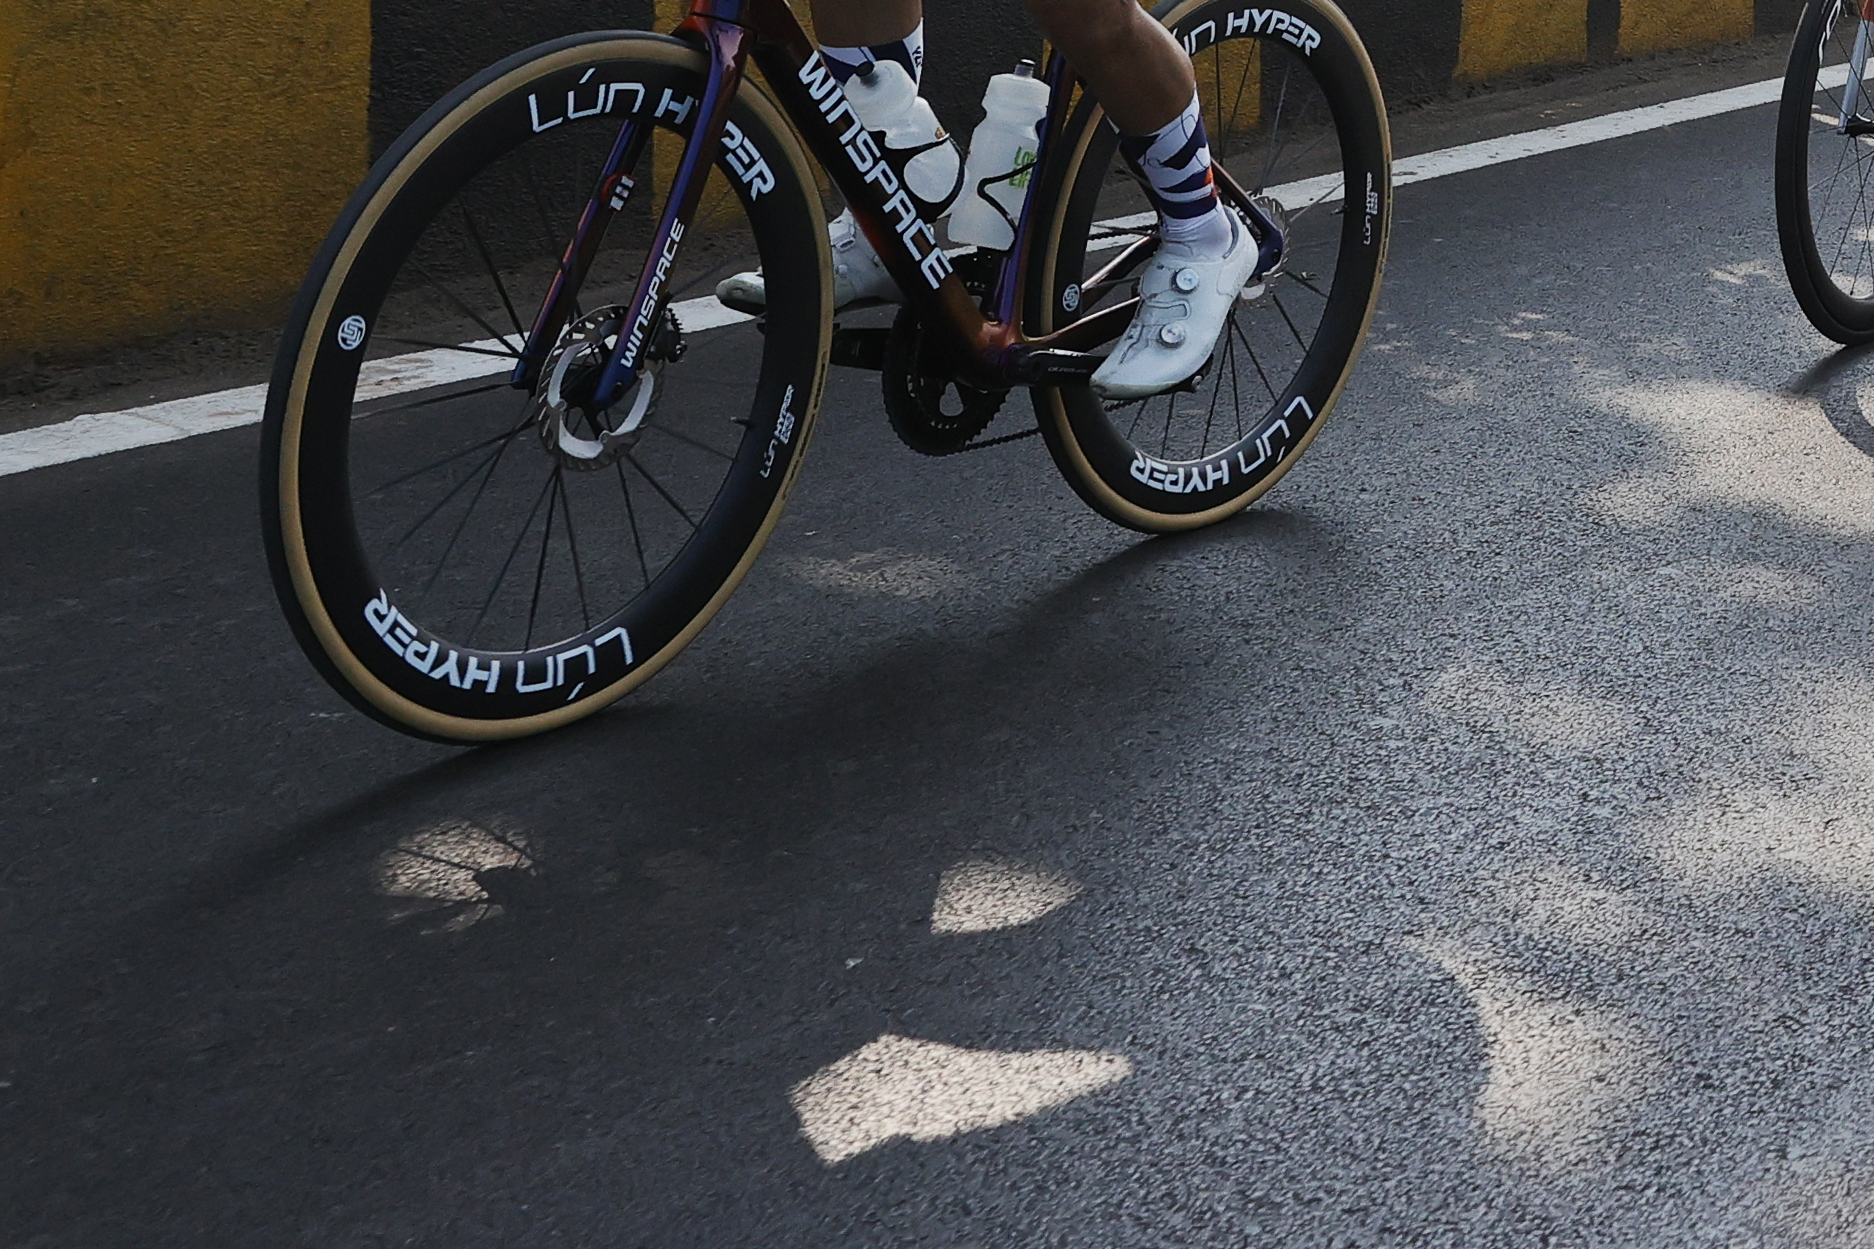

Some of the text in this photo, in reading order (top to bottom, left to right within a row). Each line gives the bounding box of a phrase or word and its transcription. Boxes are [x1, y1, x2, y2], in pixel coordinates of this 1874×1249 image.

[1225, 8, 1322, 57] HYPER
[653, 88, 776, 201] HPER
[798, 50, 954, 290] WINSPACE
[621, 217, 685, 369] WINSPACE
[1129, 450, 1230, 494] HYPER
[364, 587, 500, 693] HYPER
